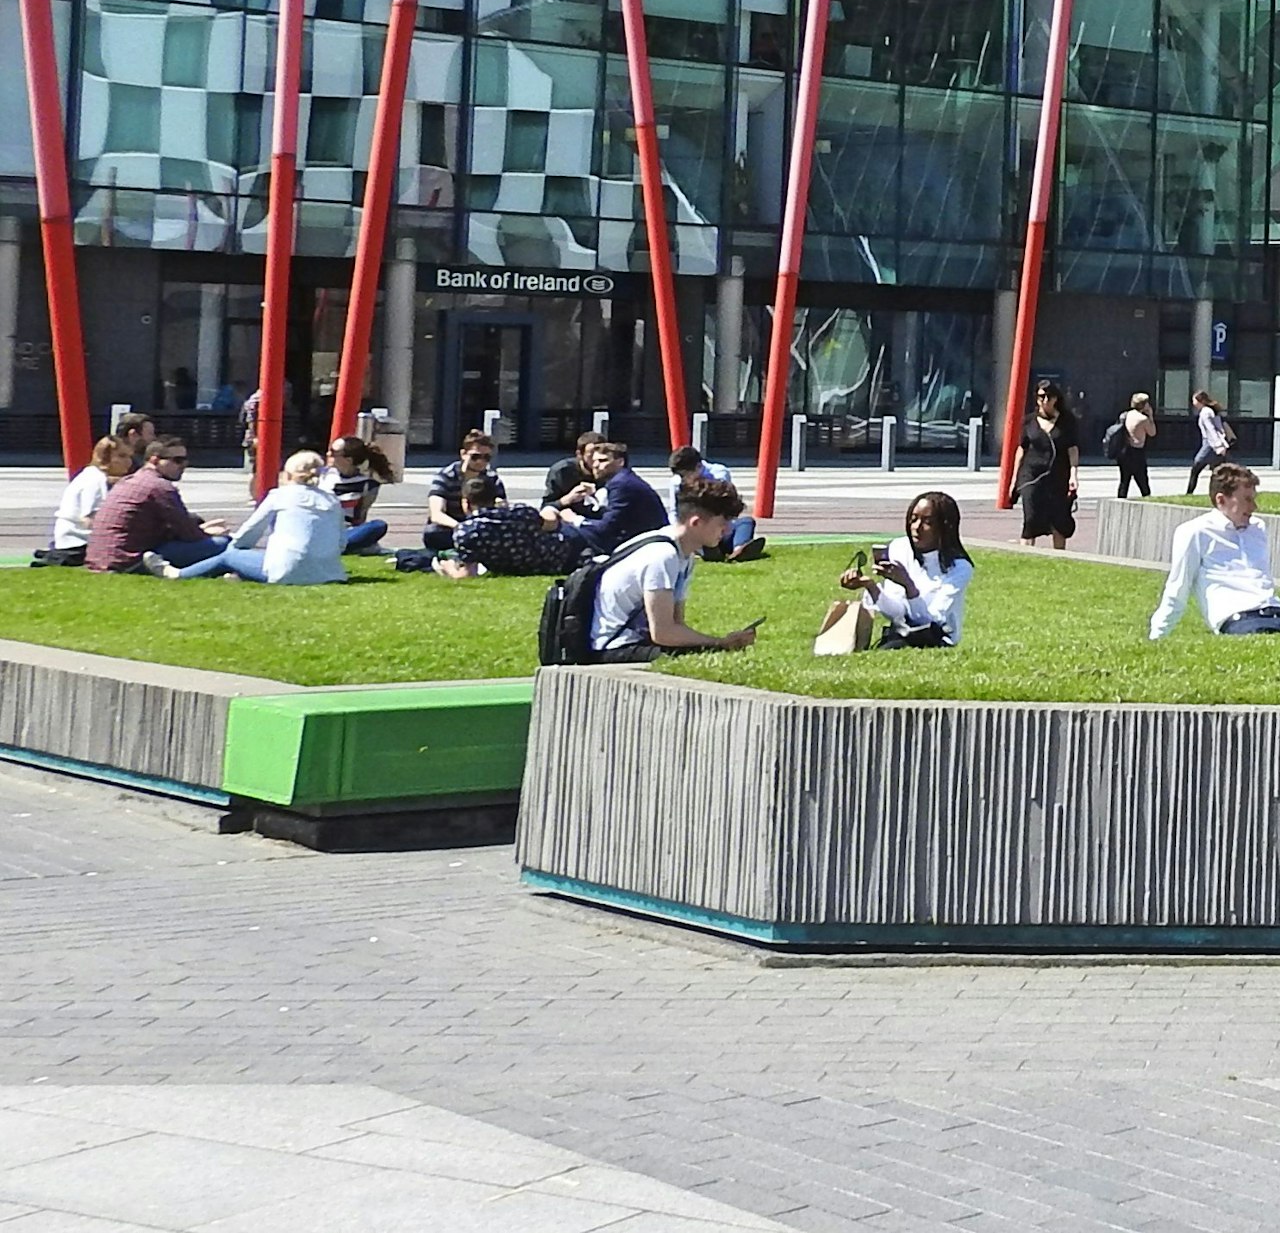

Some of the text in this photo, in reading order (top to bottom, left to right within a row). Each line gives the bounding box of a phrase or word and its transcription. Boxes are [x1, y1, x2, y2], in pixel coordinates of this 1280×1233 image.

[436, 269, 581, 293] Bank of Ireland
[1215, 327, 1227, 352] P
